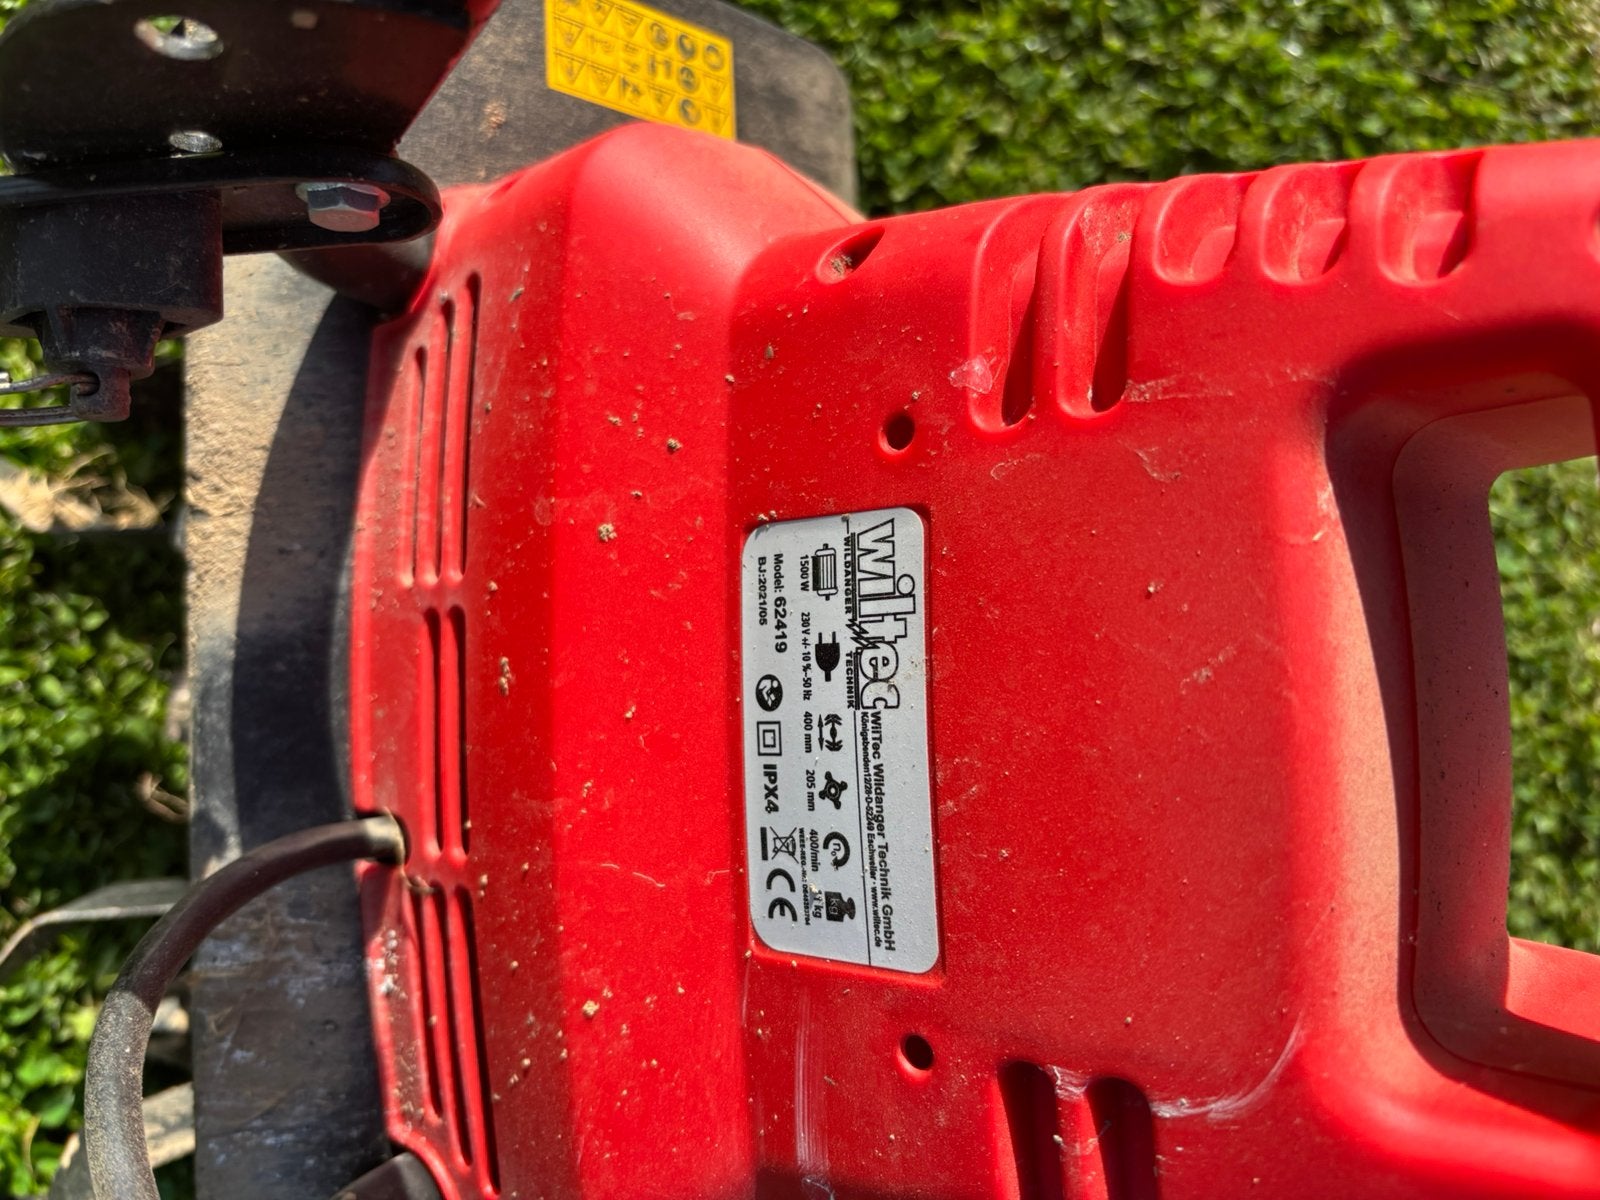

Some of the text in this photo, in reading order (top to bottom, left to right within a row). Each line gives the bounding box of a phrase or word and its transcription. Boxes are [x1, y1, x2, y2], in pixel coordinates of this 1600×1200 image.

[758, 556, 768, 626] BJ:2021/05
[800, 554, 809, 592] 1500 W
[773, 553, 787, 653] Model: 62419
[801, 612, 810, 628] 230
[844, 536, 854, 709] WILDANGER TECHNIK
[802, 651, 811, 662] 10
[803, 689, 812, 701] Hz
[804, 711, 813, 753] 400 mm
[762, 763, 779, 810] IPX4
[806, 769, 816, 812] 205 mm
[809, 829, 820, 872] 400/min
[870, 711, 896, 951] WilTec Wildanger Technik GmbH
[867, 833, 877, 880] Eschweiler
[812, 905, 824, 919] kg
[871, 886, 882, 947] www.wiltec.de
